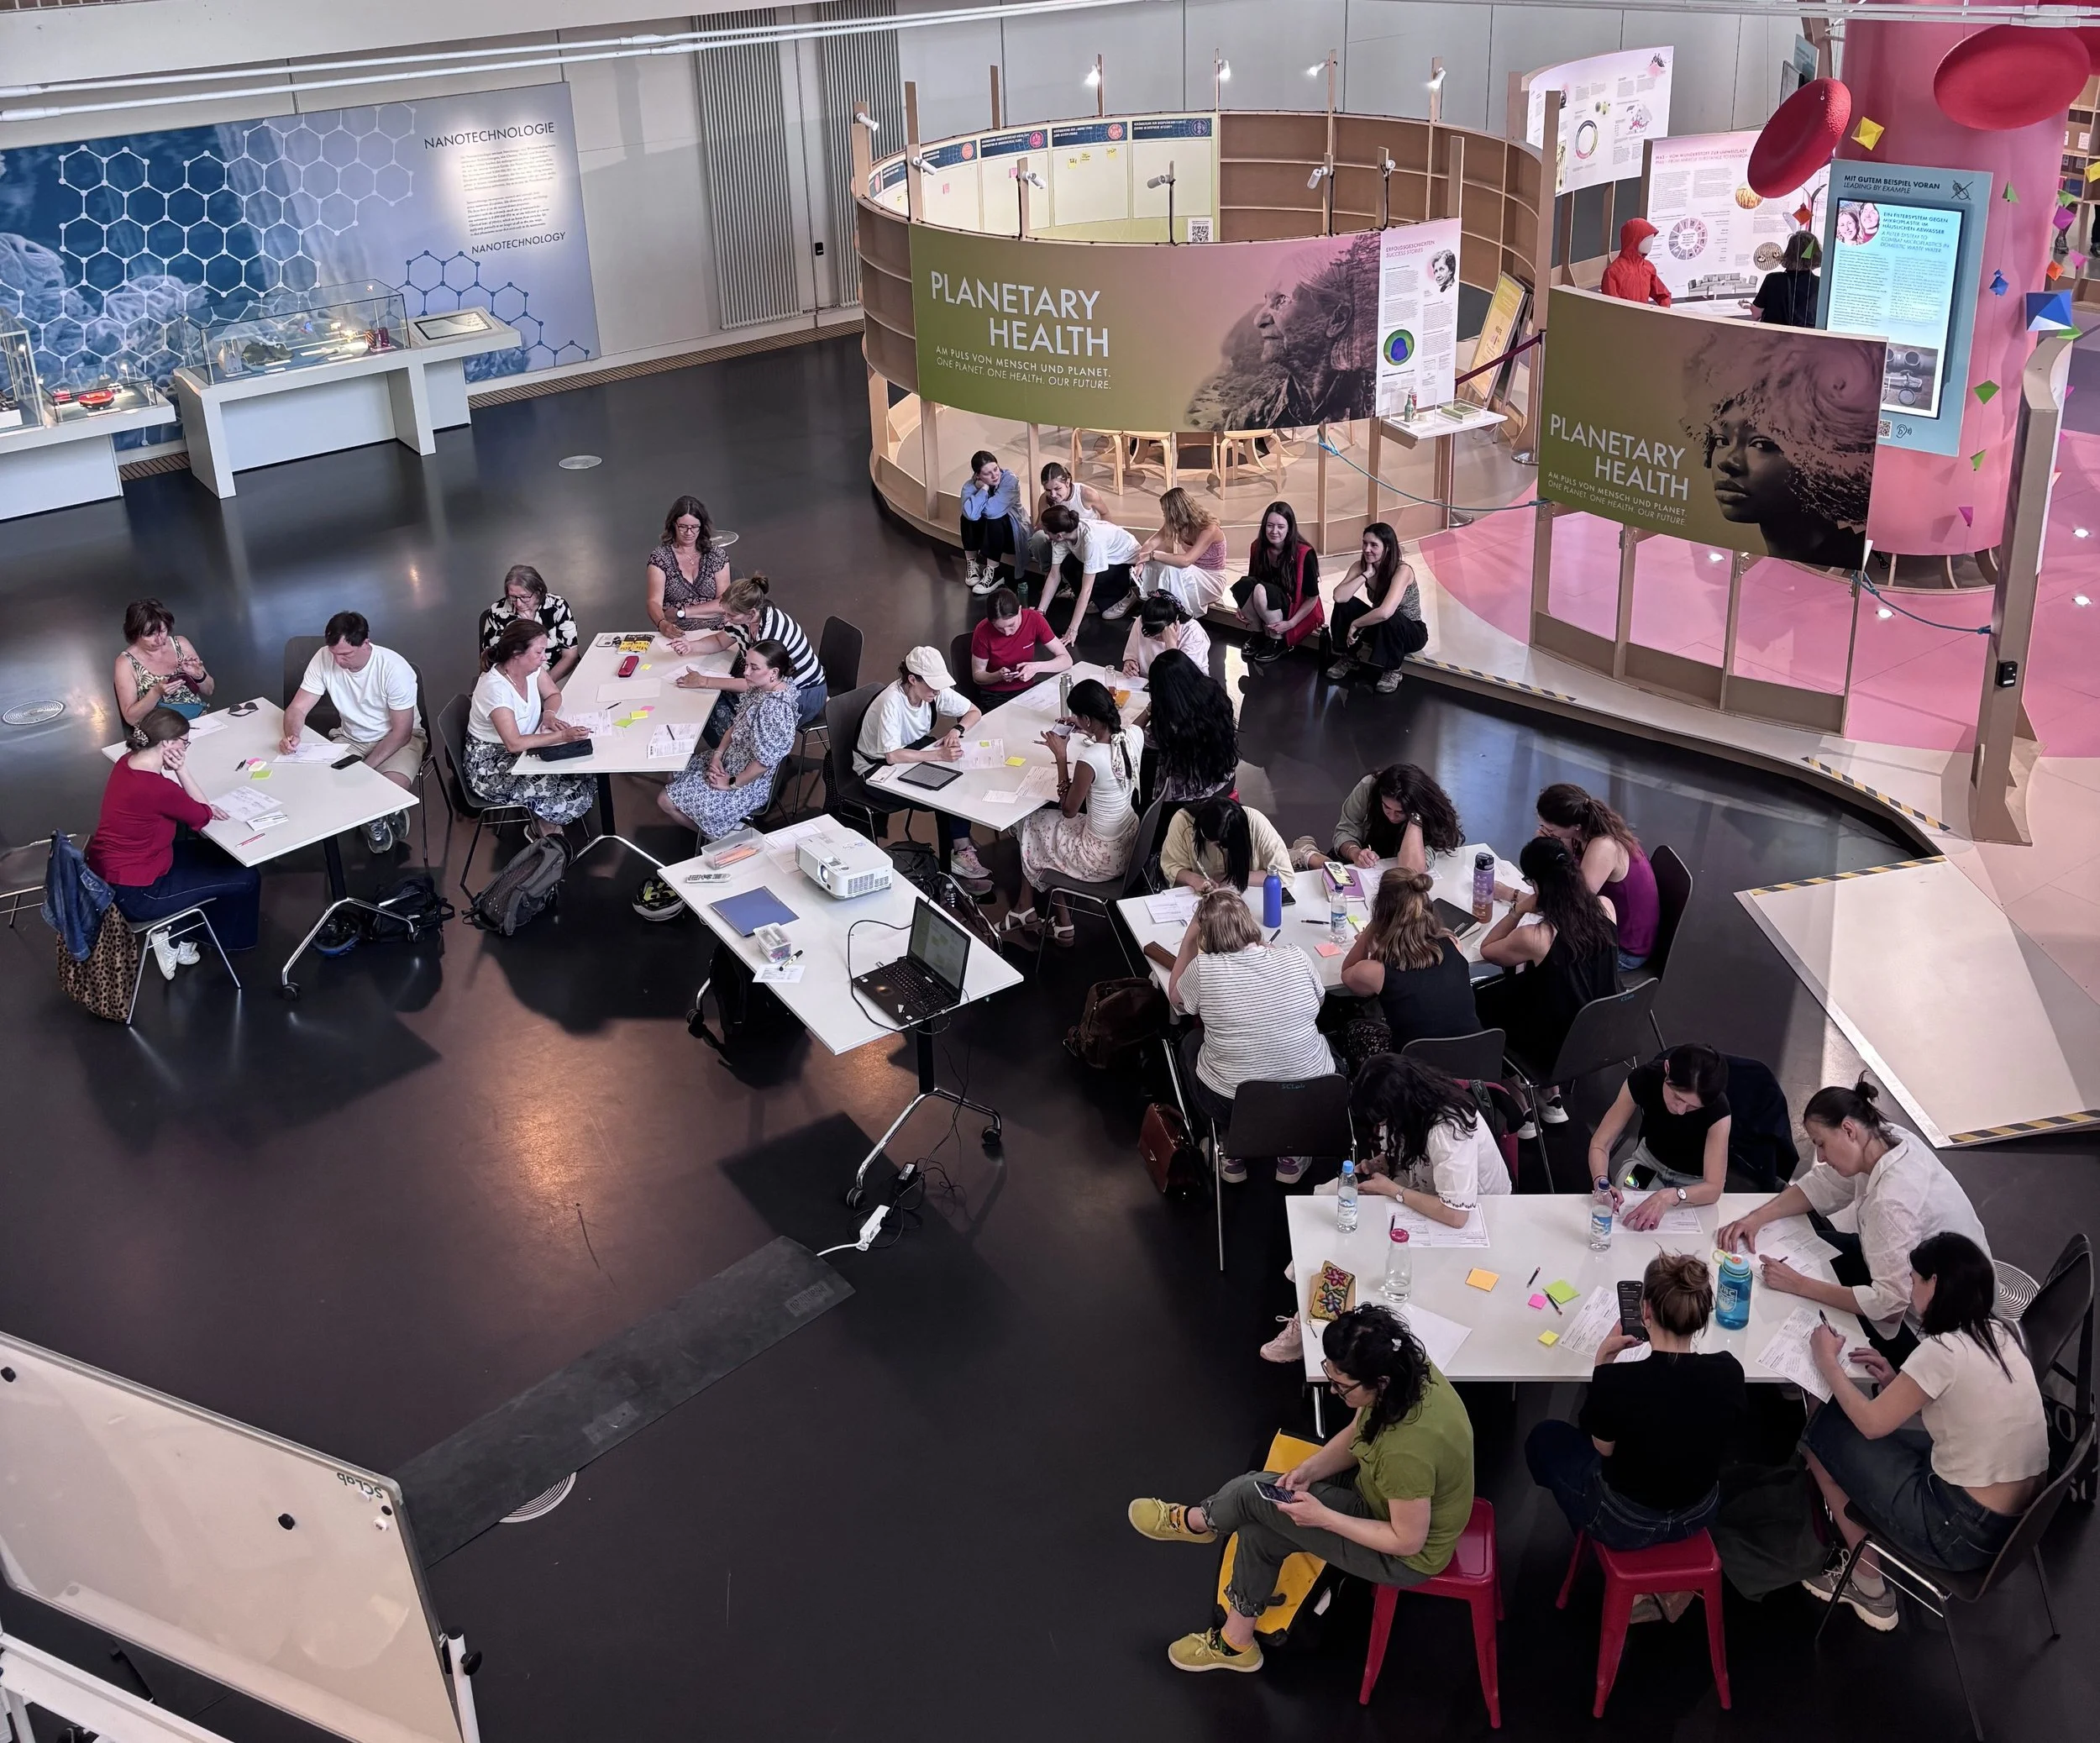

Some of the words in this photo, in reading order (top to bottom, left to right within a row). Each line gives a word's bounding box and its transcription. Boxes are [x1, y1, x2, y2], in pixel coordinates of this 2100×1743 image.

[424, 122, 554, 150] NANOTECHNOLOGIE
[1843, 181, 1872, 191] LEADING
[1882, 186, 1911, 194] EXAMPLE
[1858, 176, 1882, 185] GUTEM
[1883, 178, 1911, 187] BEISPIEL
[1914, 181, 1940, 190] VORAN
[471, 232, 566, 255] NANOTECHNOLOGY
[931, 270, 1100, 320] PLANETARY
[990, 318, 1109, 358] HEALTH
[936, 345, 948, 355] AM
[951, 349, 969, 361] PULS
[972, 353, 992, 365] VON
[995, 358, 1037, 371] MENSCH
[1041, 364, 1063, 374] UND
[1068, 366, 1111, 378] PLANET.
[937, 356, 953, 368] ONE
[955, 361, 984, 375] PLANET.
[987, 368, 1006, 379] ONE
[1010, 372, 1045, 385] HEALTH.
[1048, 376, 1069, 387] OUR
[1073, 378, 1111, 390] FUTURE.
[1550, 413, 1686, 470] PLANETARY
[1548, 471, 1559, 480] AM
[1561, 475, 1577, 486] PULS
[1578, 480, 1595, 492] VON
[1598, 487, 1630, 502] MENSCH
[1633, 497, 1651, 508] UND
[1654, 502, 1688, 517] PLANET.
[1594, 455, 1689, 501] HEALTH
[1548, 480, 1562, 491] ONE
[1589, 494, 1606, 505] ONE
[1607, 499, 1635, 513] HEALTH.
[1638, 507, 1654, 517] OUR
[1656, 512, 1687, 527] FUTURE.
[337, 1472, 384, 1499] SCLab
